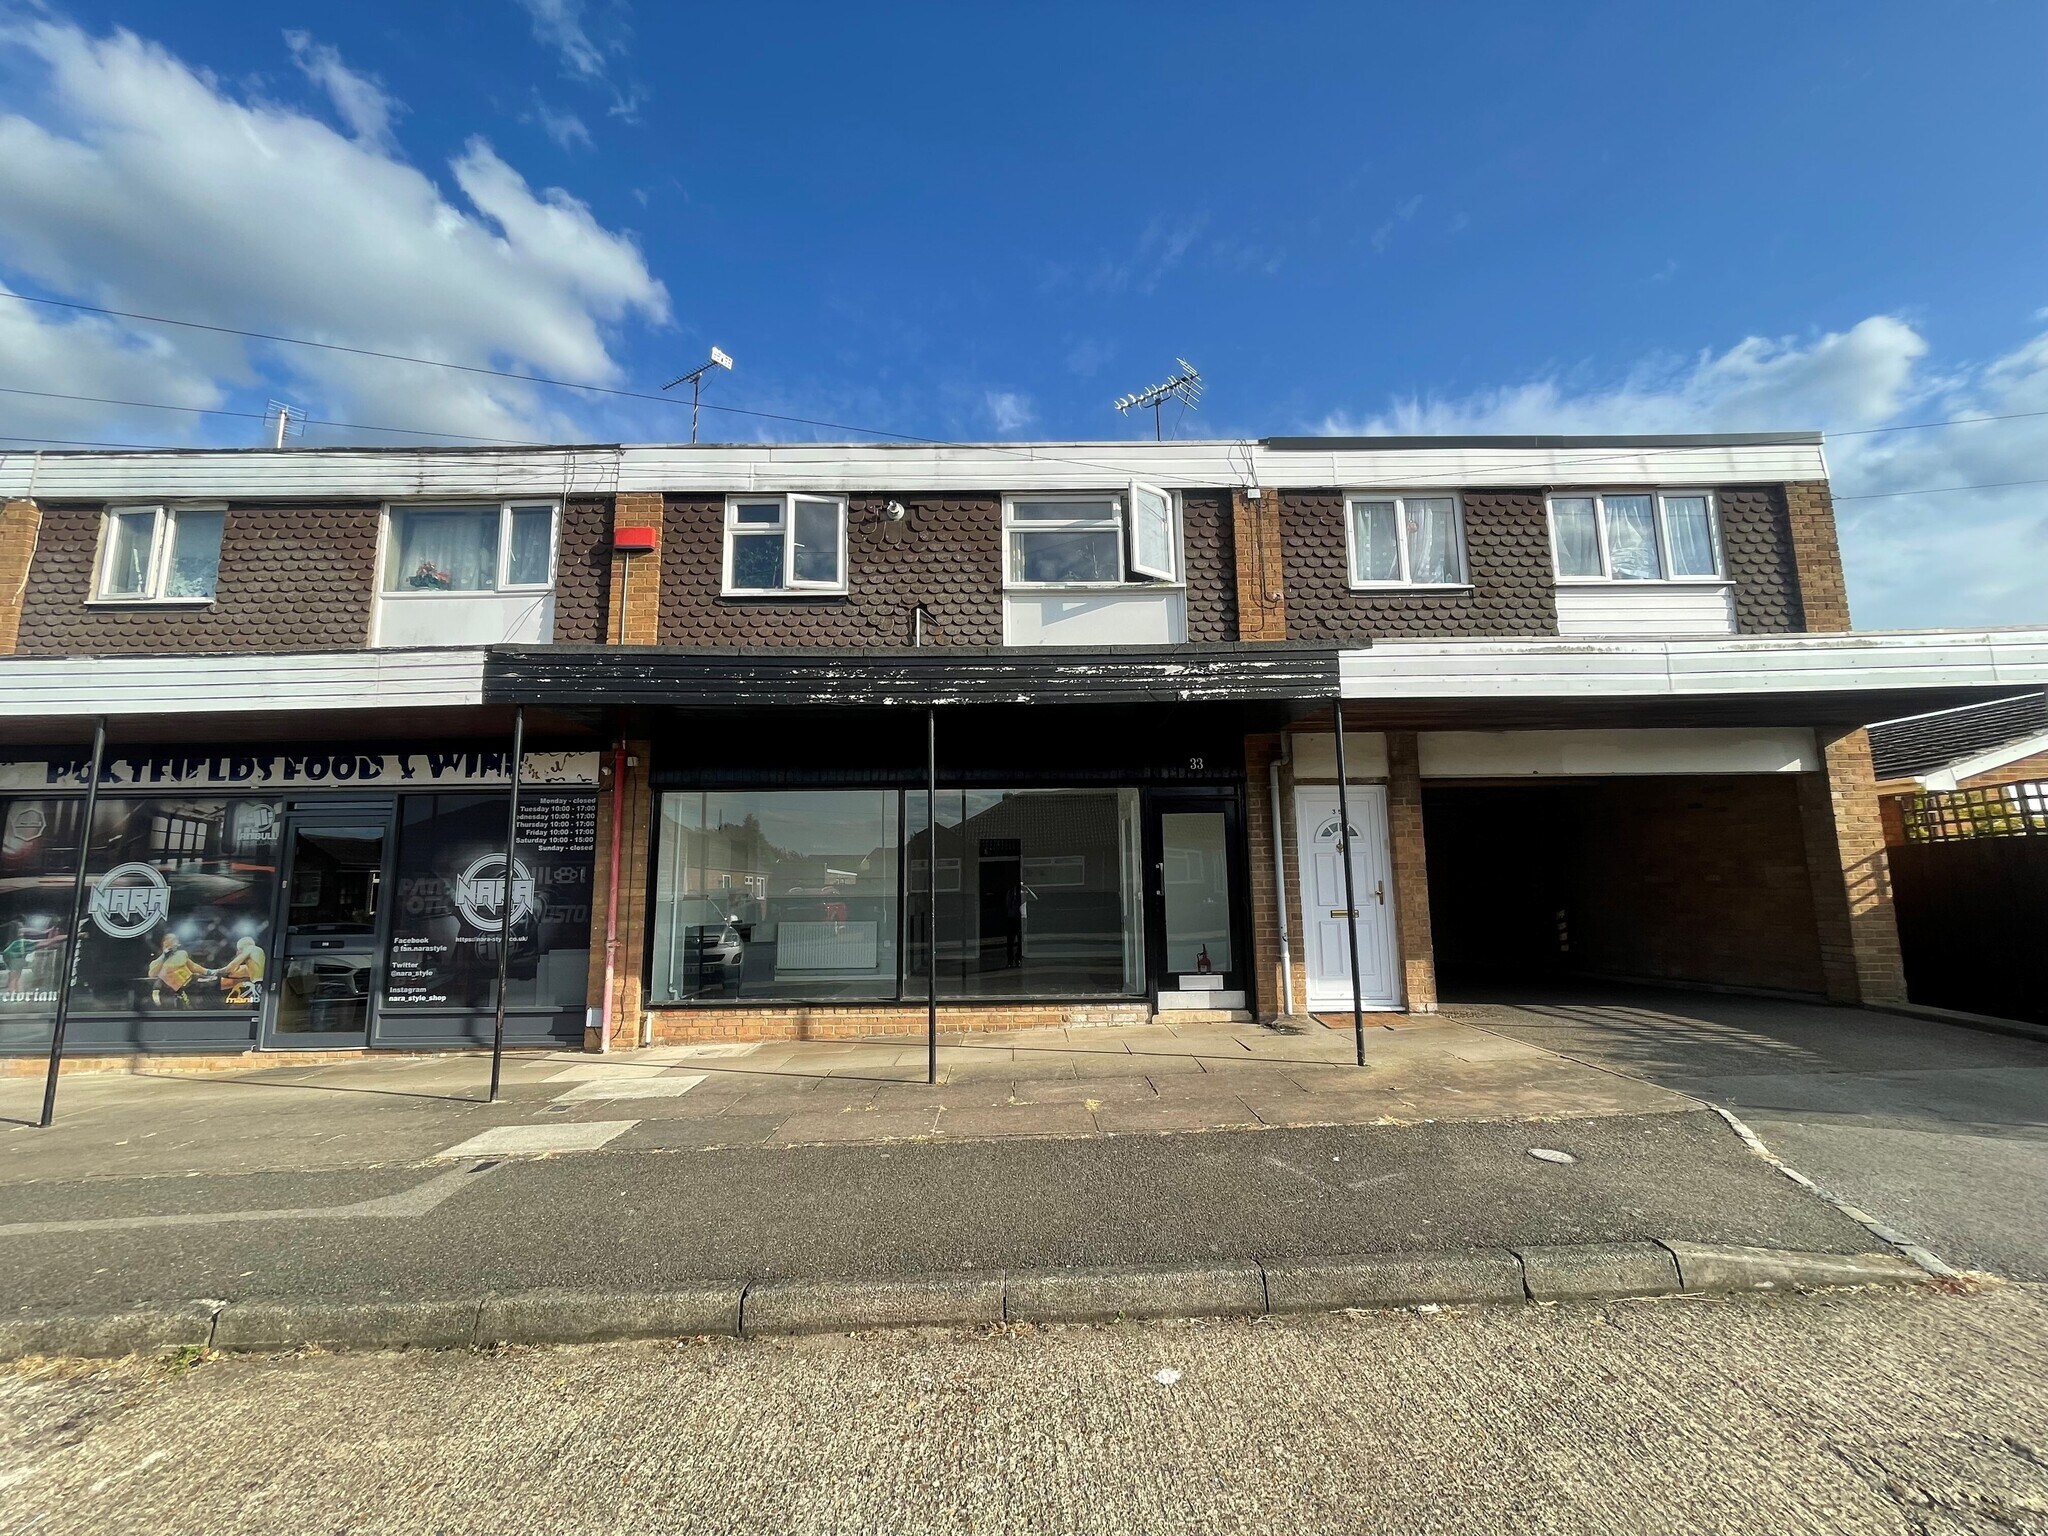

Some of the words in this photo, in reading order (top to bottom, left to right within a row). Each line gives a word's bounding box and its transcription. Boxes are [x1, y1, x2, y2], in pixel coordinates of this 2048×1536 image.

[283, 756, 385, 780] FOOD
[1190, 757, 1203, 769] 33
[88, 883, 172, 921] NARA
